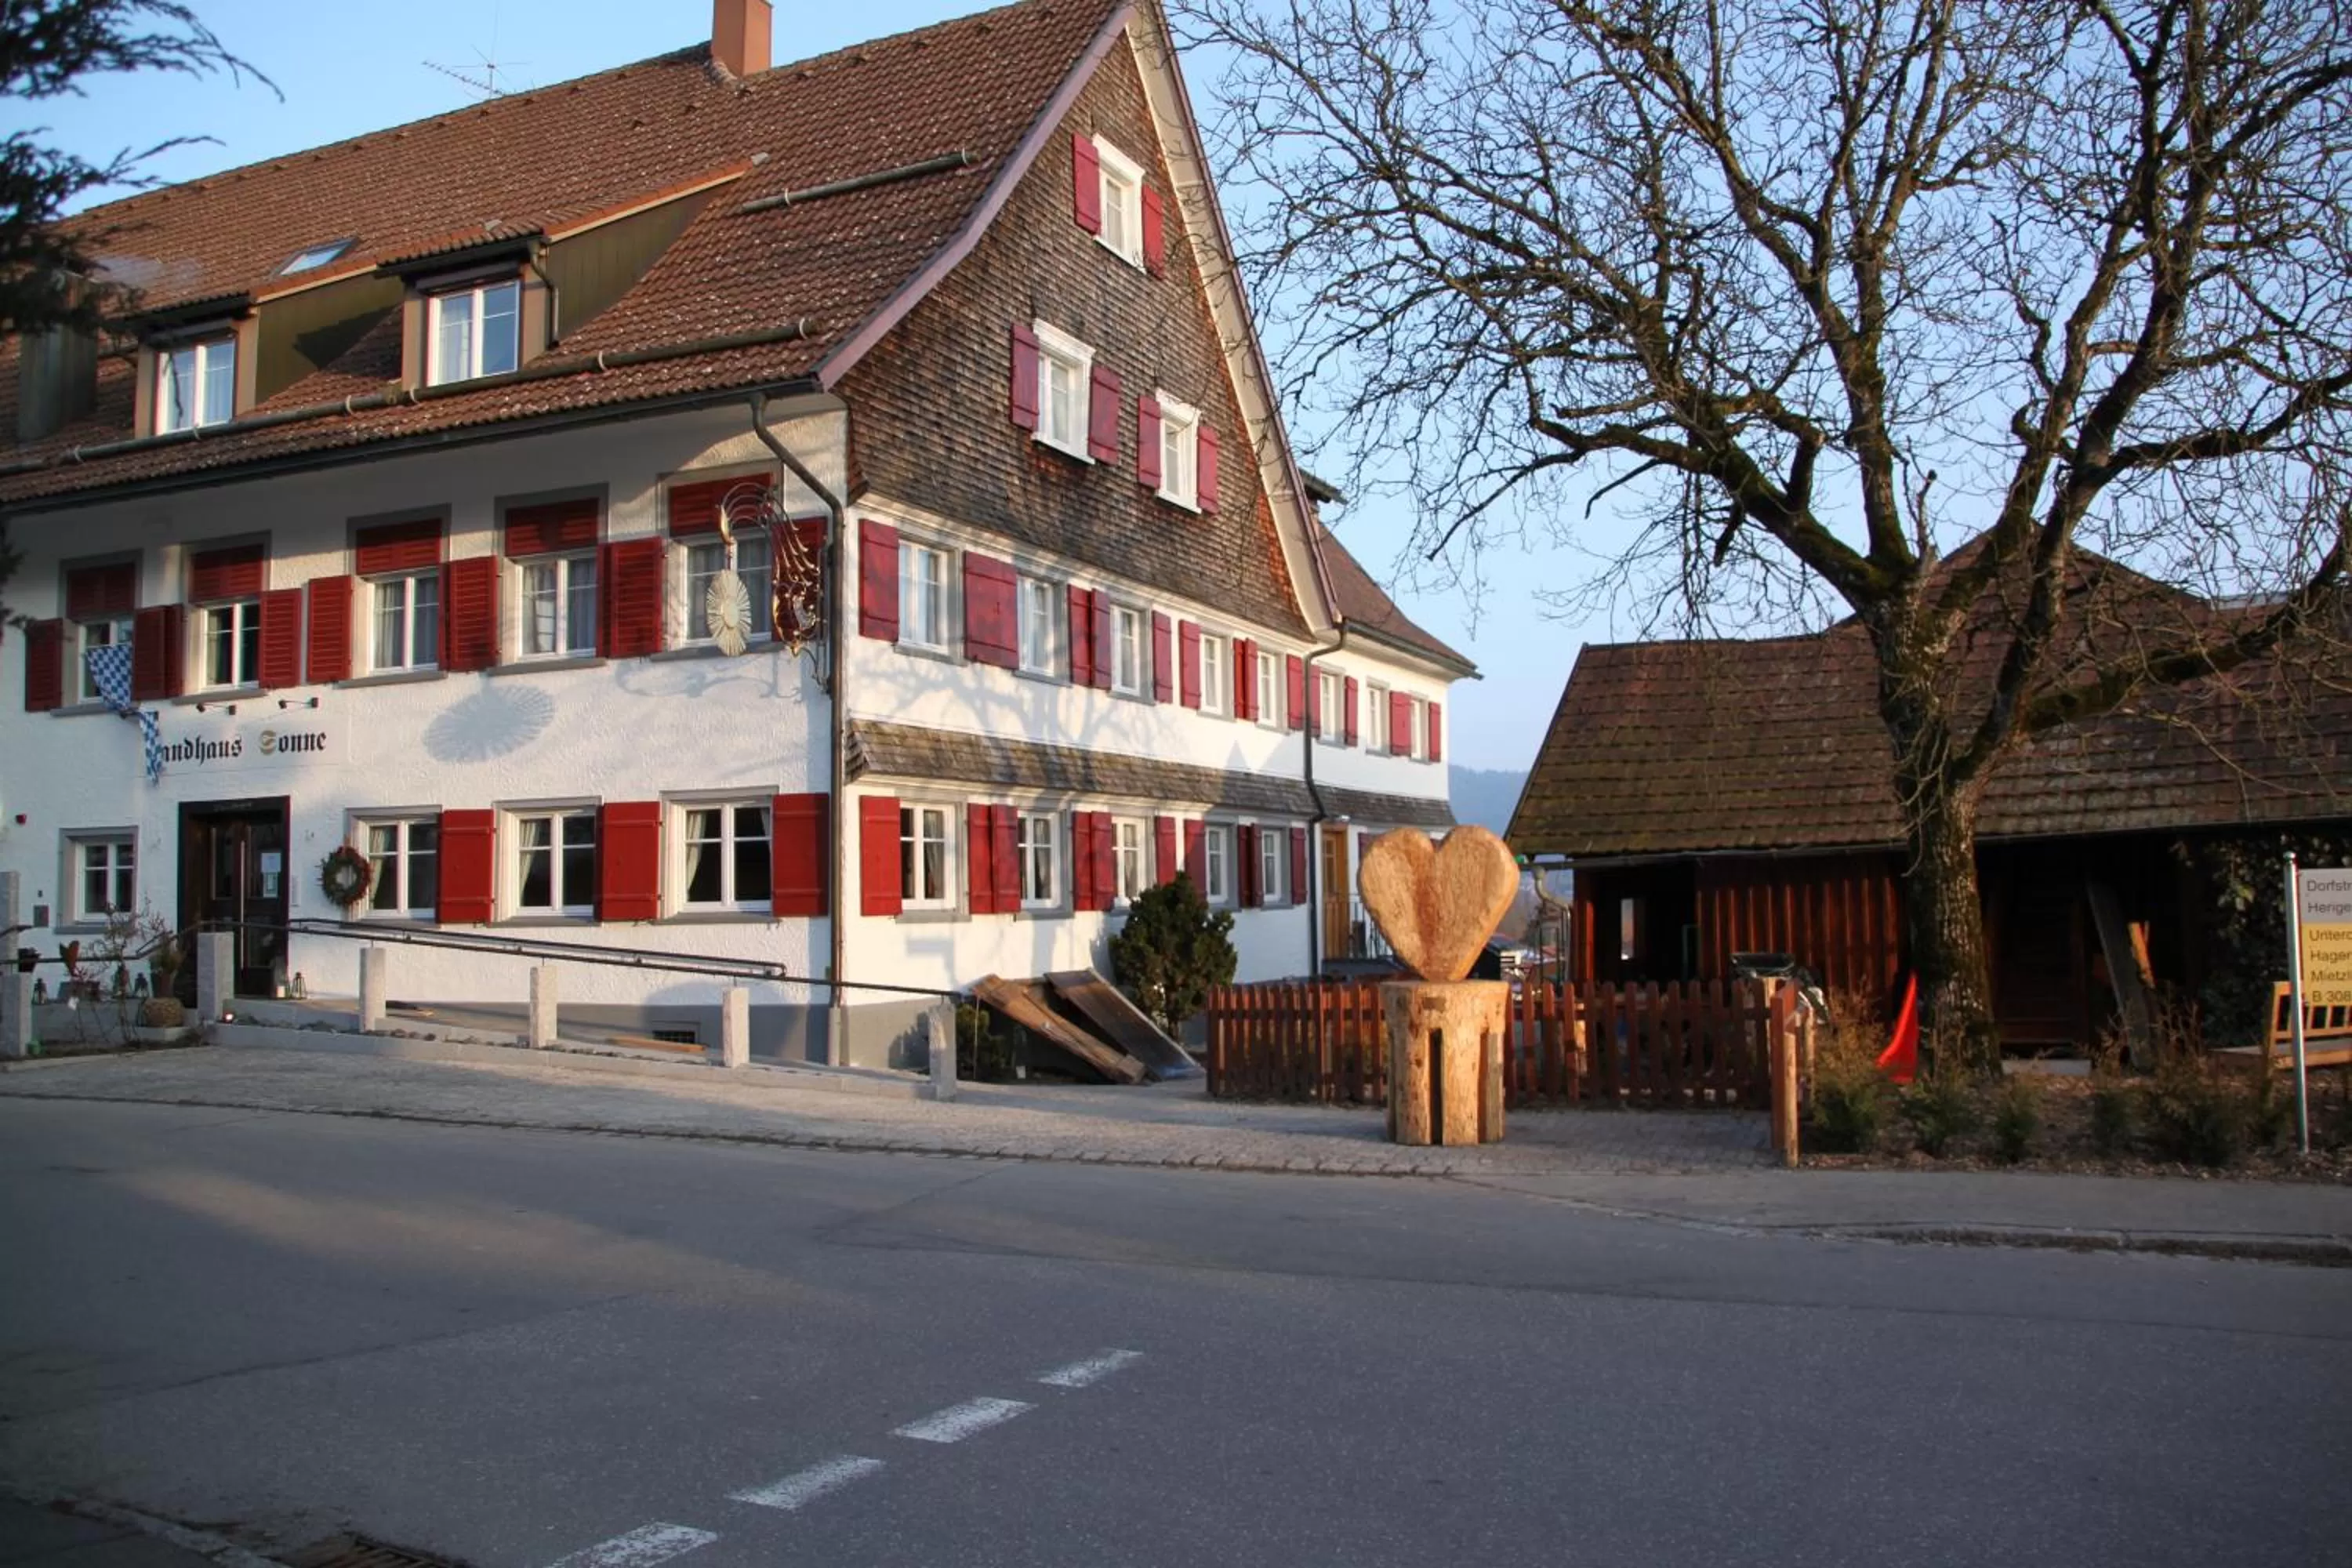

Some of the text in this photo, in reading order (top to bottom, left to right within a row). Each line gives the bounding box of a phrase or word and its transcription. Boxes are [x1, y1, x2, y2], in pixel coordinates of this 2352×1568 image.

[161, 730, 327, 765] andhaus Sonne
[2312, 990, 2321, 1002] B
